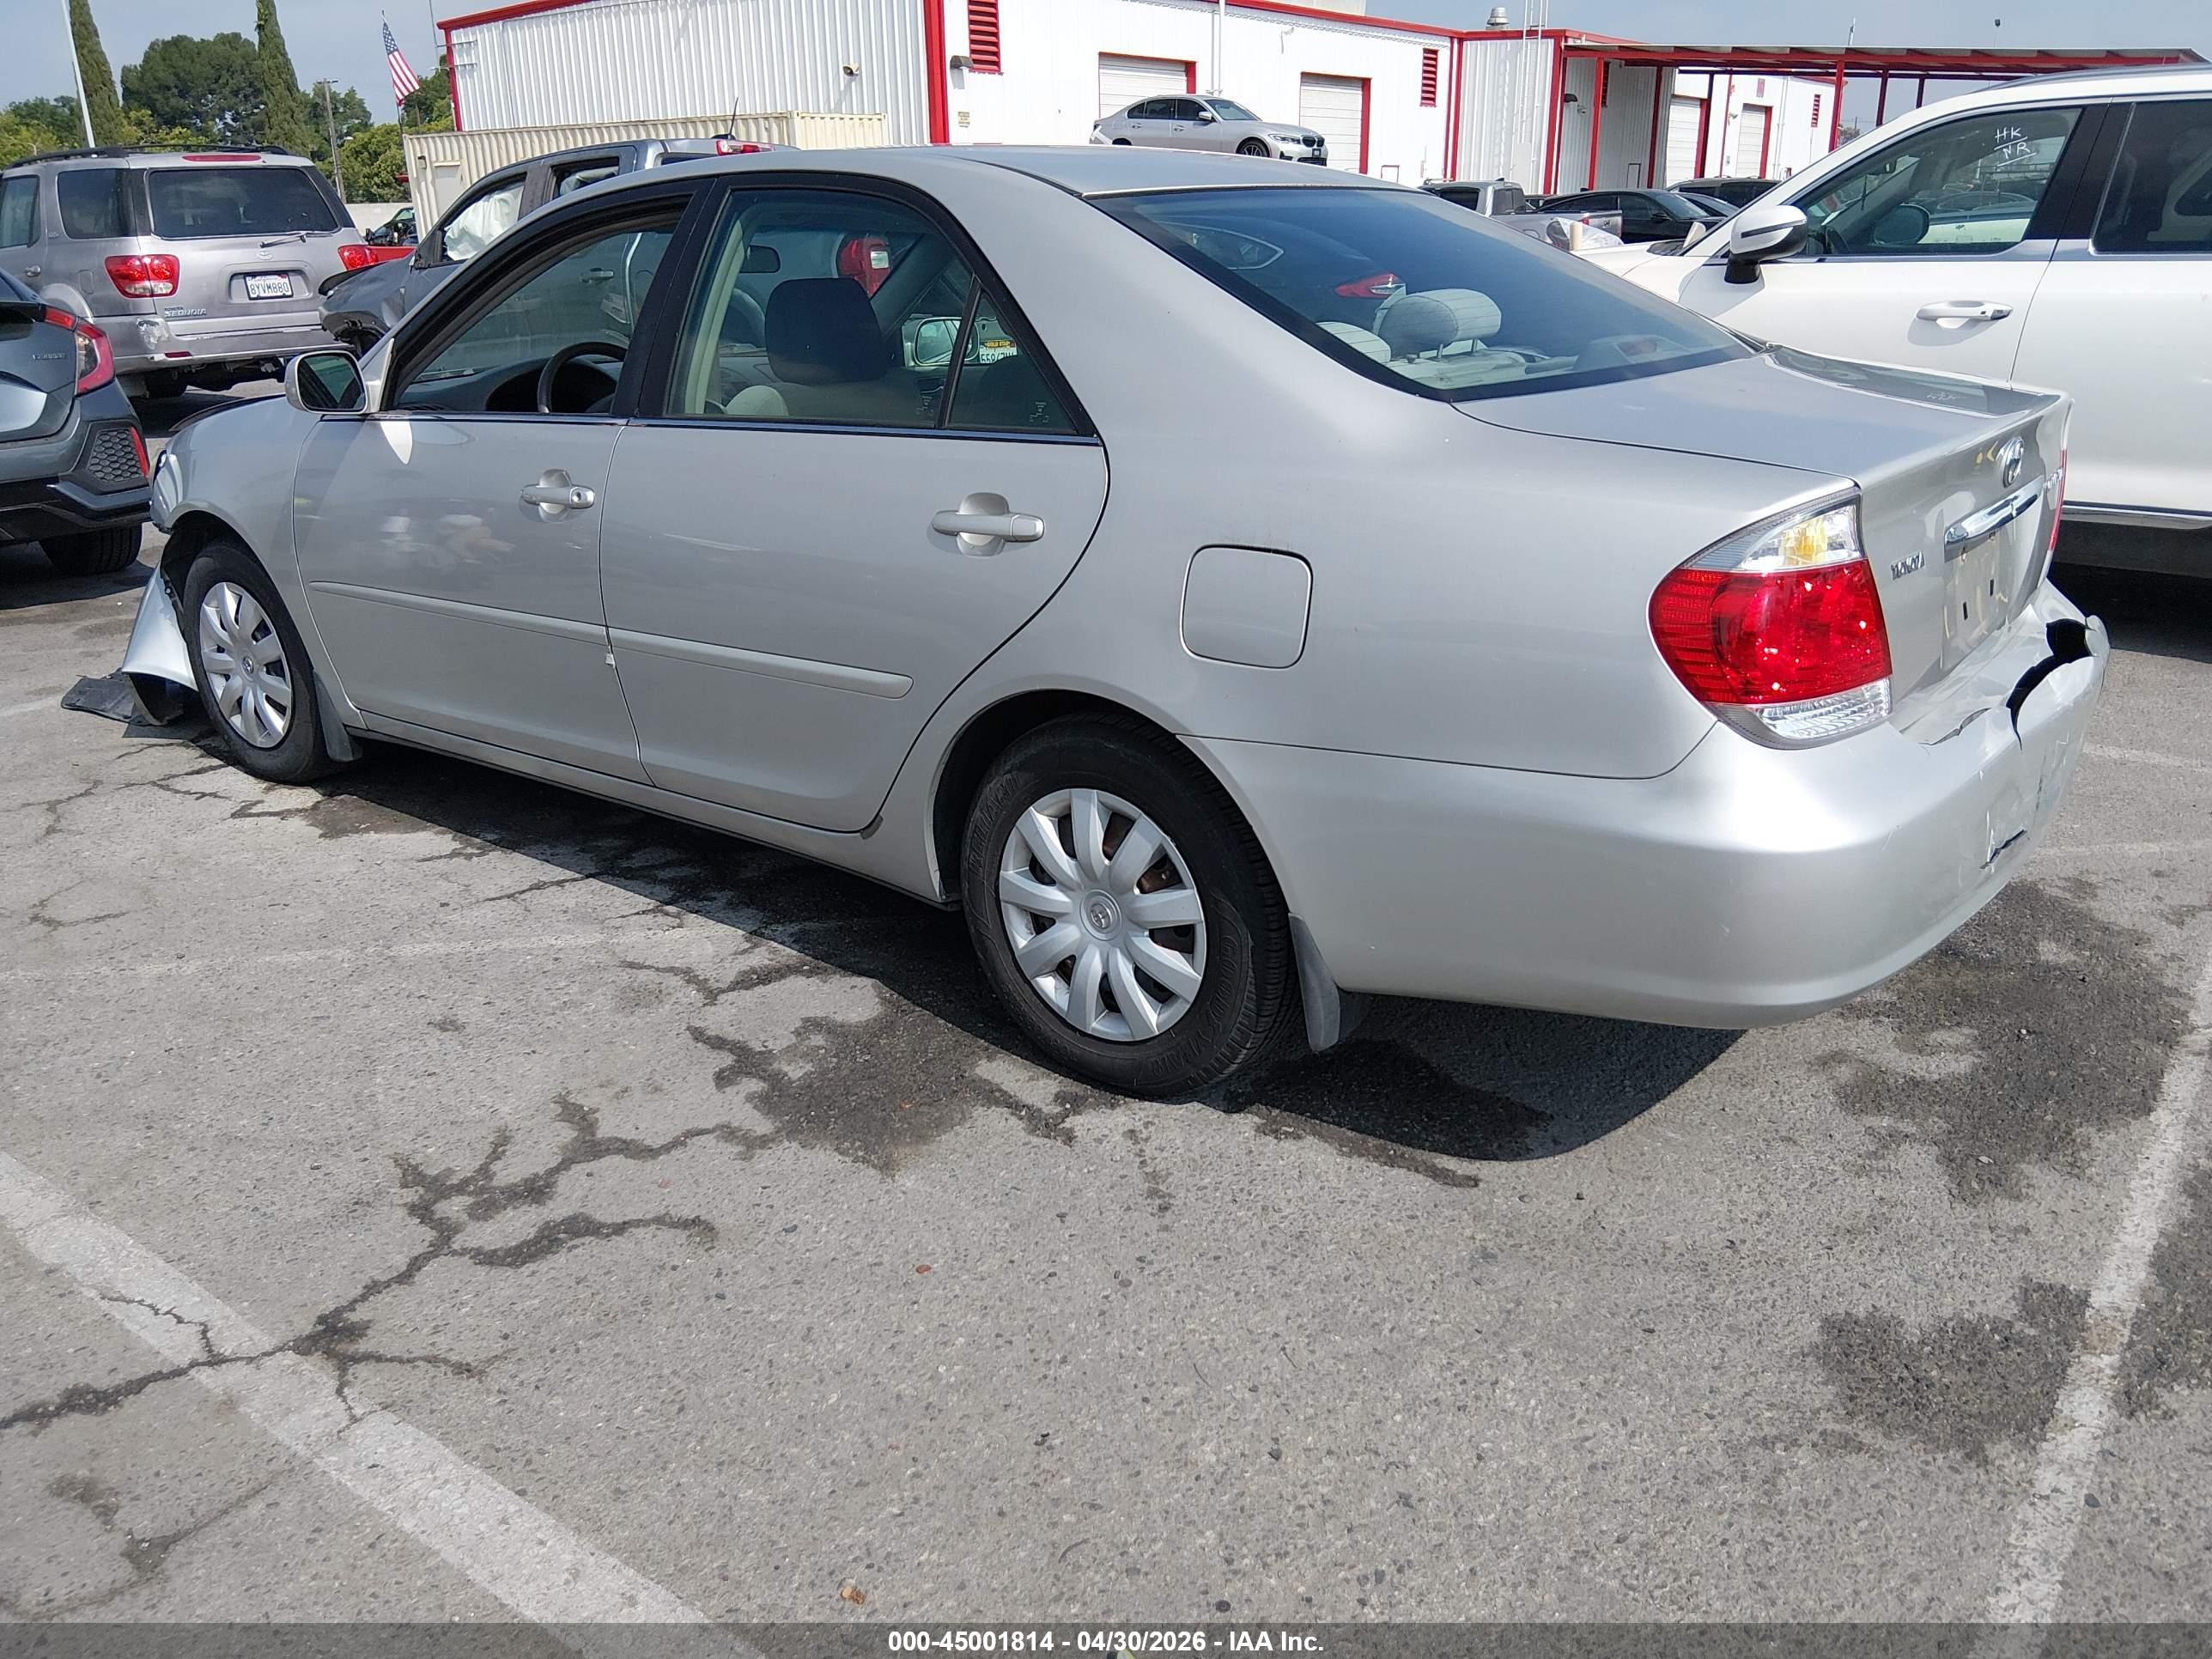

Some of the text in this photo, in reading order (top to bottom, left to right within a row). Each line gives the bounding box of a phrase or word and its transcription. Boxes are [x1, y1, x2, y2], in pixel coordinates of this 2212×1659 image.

[1994, 126, 2021, 143] HK
[250, 281, 289, 295] 8YVM880
[164, 308, 207, 317] SEQUOIA
[1890, 550, 1924, 580] TOYOTA
